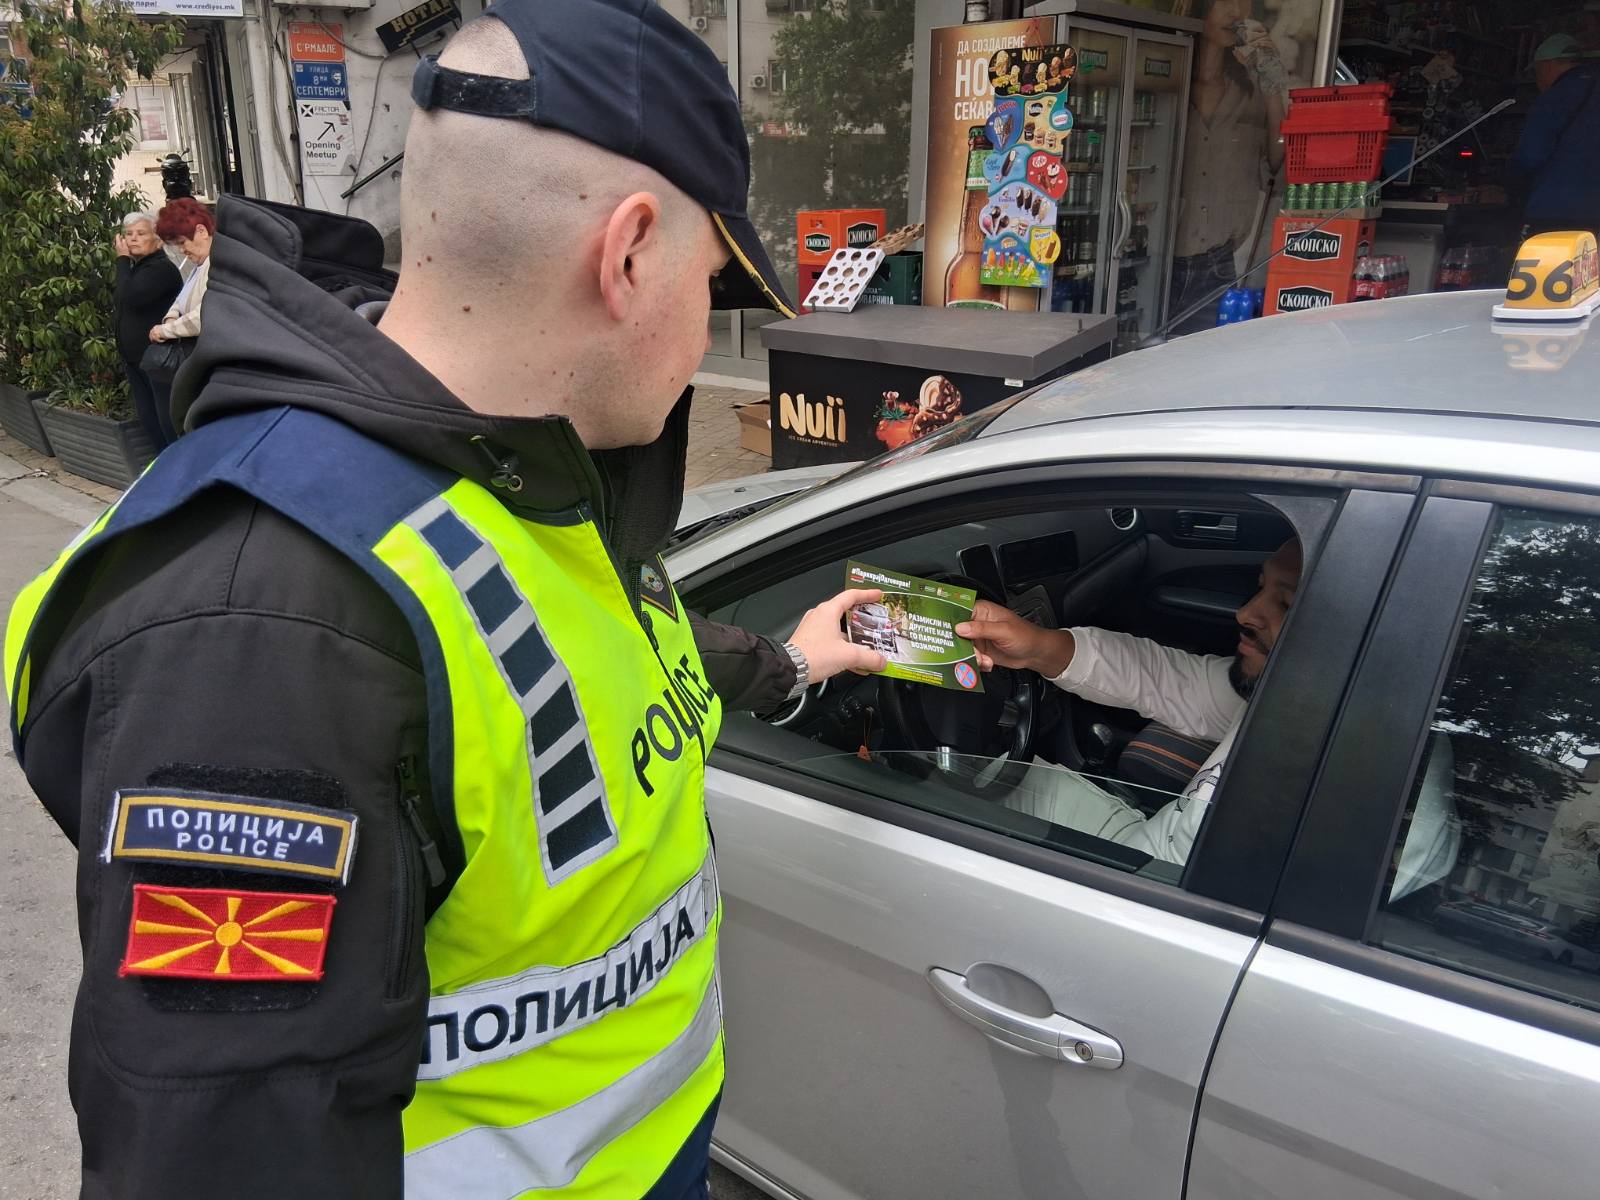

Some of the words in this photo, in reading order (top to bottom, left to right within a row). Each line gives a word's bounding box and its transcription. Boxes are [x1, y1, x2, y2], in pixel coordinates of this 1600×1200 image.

[956, 40, 970, 57] ДА
[954, 57, 996, 98] НО
[296, 85, 347, 97] СЕПТЕМВРИ
[305, 141, 341, 151] Opening
[306, 151, 338, 159] Meetup
[1286, 236, 1338, 254] СКОПСКО
[1505, 259, 1574, 303] 56
[1279, 292, 1330, 309] СКОПСКО
[779, 392, 847, 442] Nuii
[908, 612, 942, 627] РАЗМИСЛИ
[942, 620, 953, 630] НА
[908, 622, 937, 636] ДРУГИТЕ
[936, 629, 953, 640] КАДЕ
[909, 631, 918, 640] ГО
[911, 641, 945, 654] ВОЗИЛОТО
[631, 653, 715, 798] POLICE
[147, 807, 325, 845] ПОЛИЦИЈА
[176, 832, 290, 860] POLICE
[420, 906, 696, 1066] ПОЛИЦИЈА
